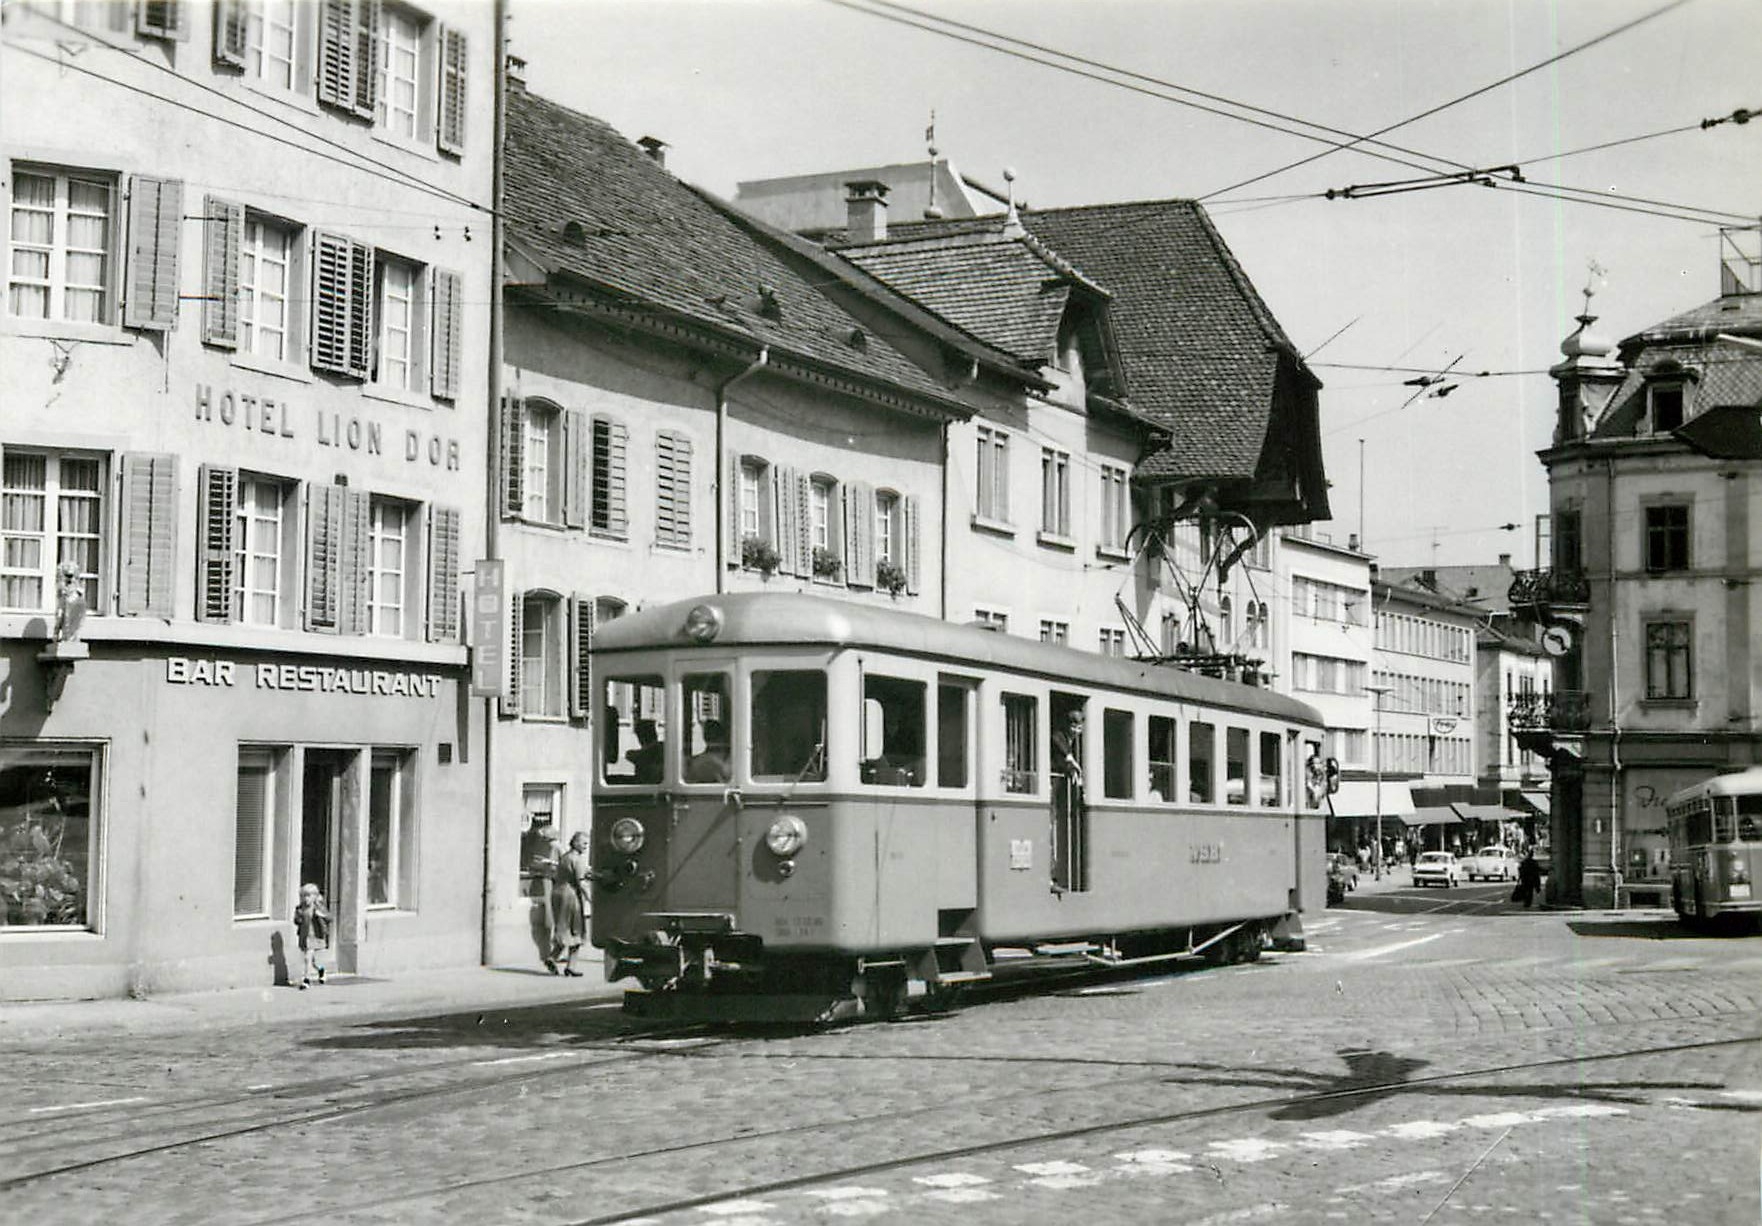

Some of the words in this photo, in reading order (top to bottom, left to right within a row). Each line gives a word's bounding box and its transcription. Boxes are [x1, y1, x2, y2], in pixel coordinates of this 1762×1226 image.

[195, 383, 294, 439] HOTEL
[318, 410, 381, 455] LION
[478, 567, 499, 690] HOTEL
[167, 656, 236, 686] BAR
[256, 663, 441, 698] RESTAURANT
